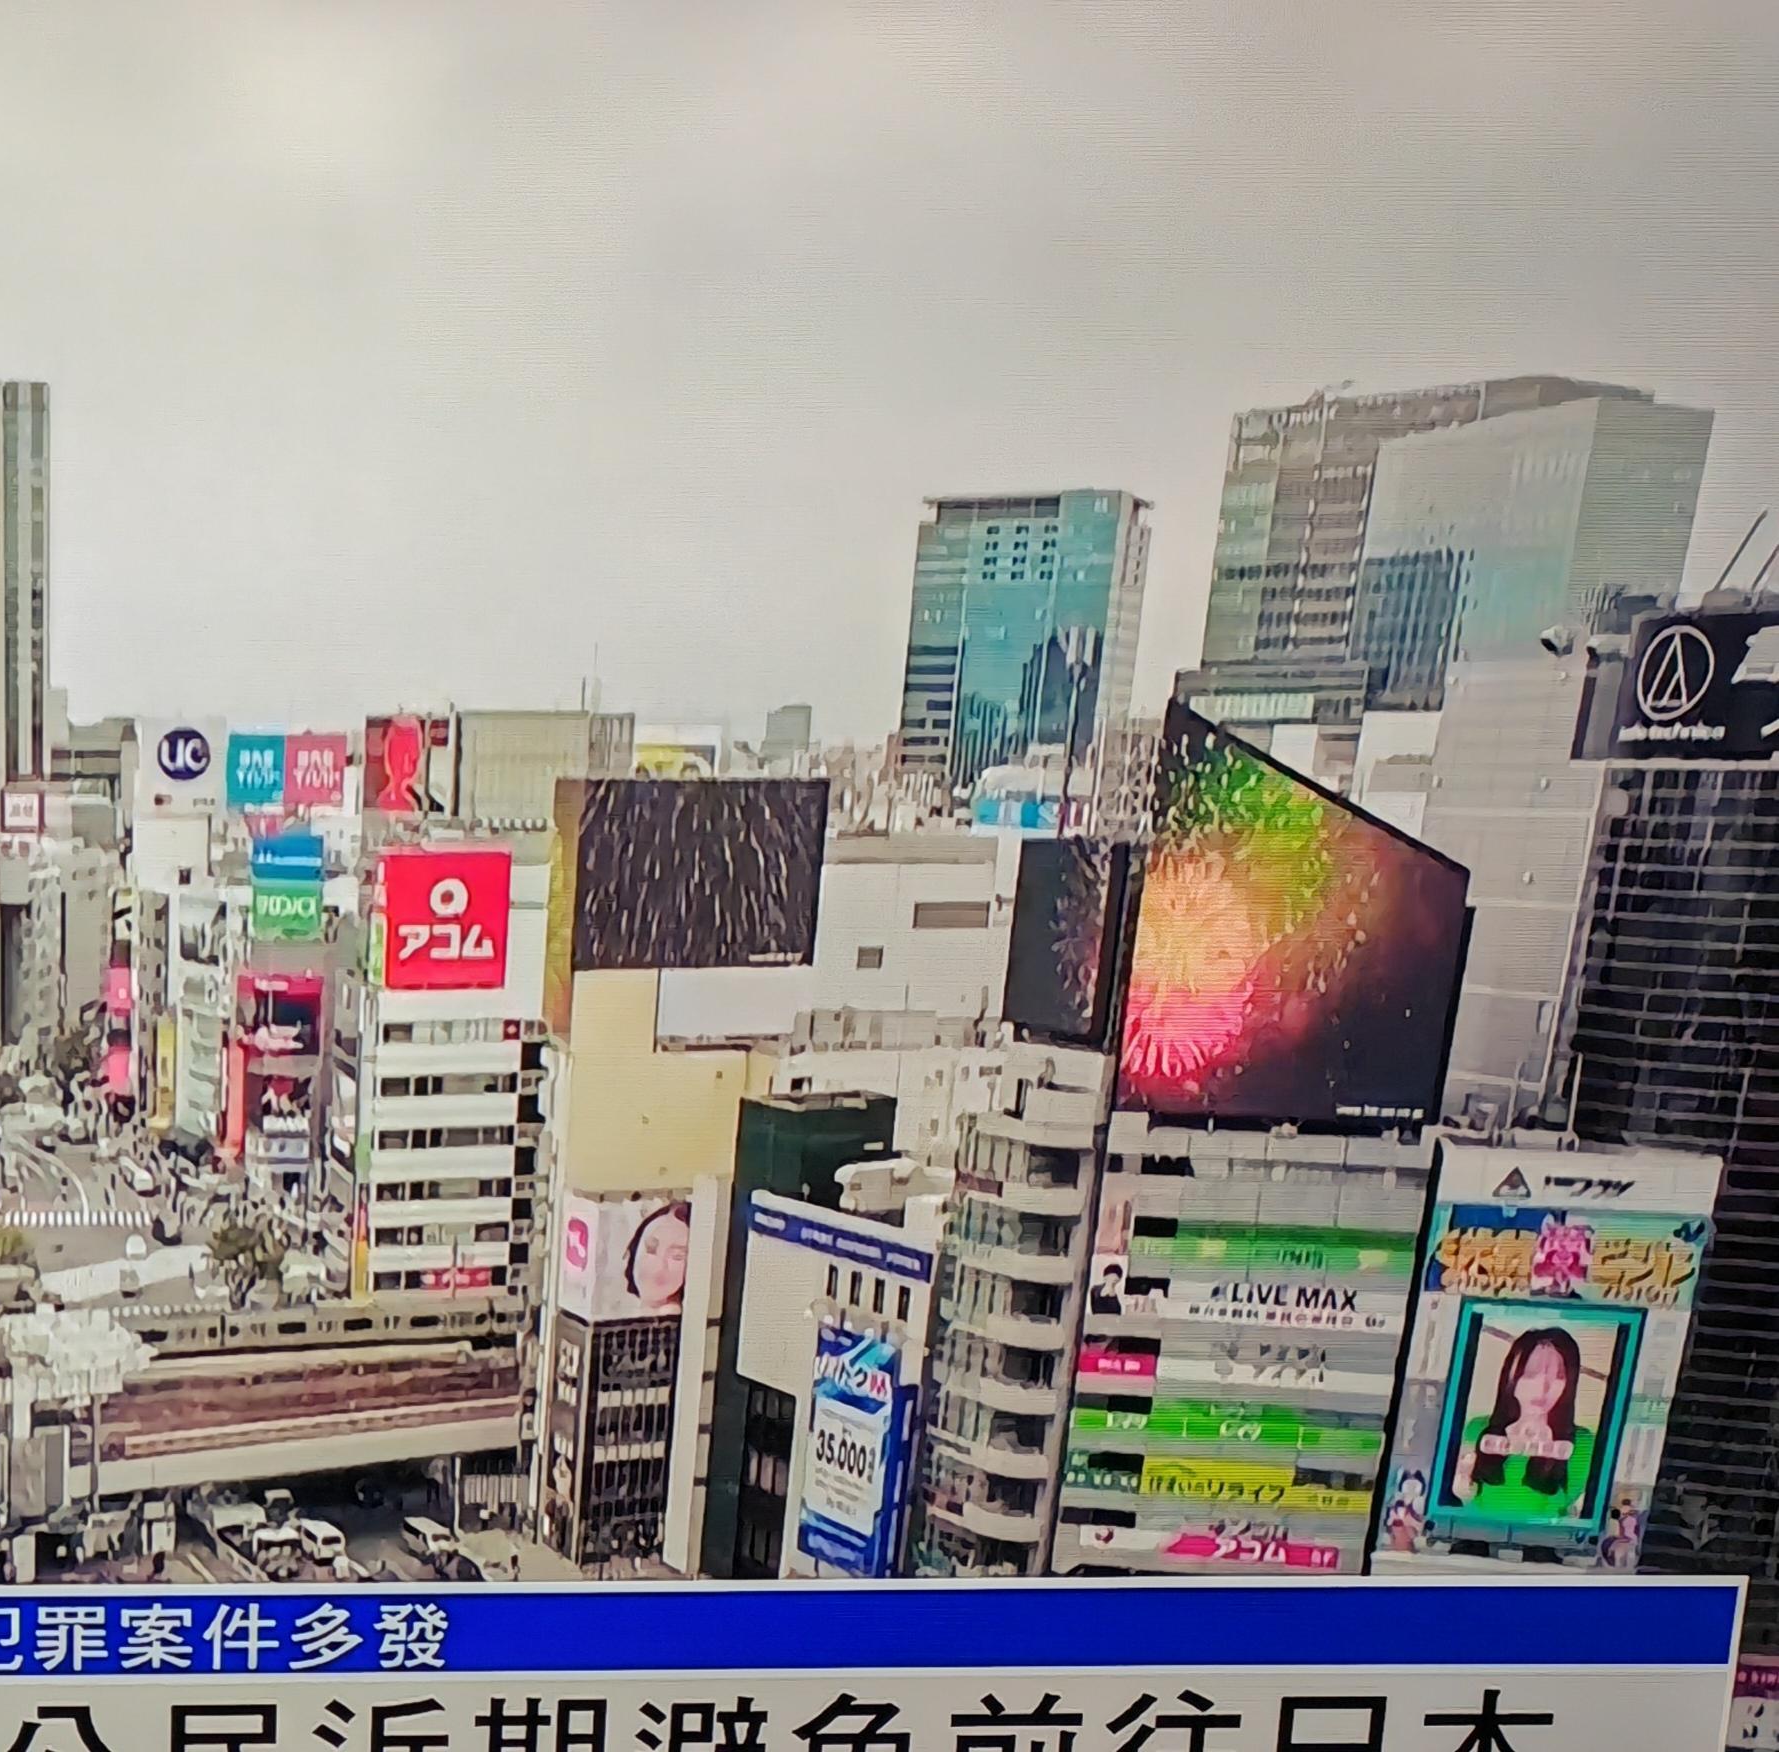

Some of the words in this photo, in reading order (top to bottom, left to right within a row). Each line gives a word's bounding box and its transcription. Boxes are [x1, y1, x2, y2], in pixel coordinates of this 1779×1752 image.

[161, 739, 210, 773] UC
[396, 923, 495, 961] アコム
[1295, 1286, 1358, 1312] MAX
